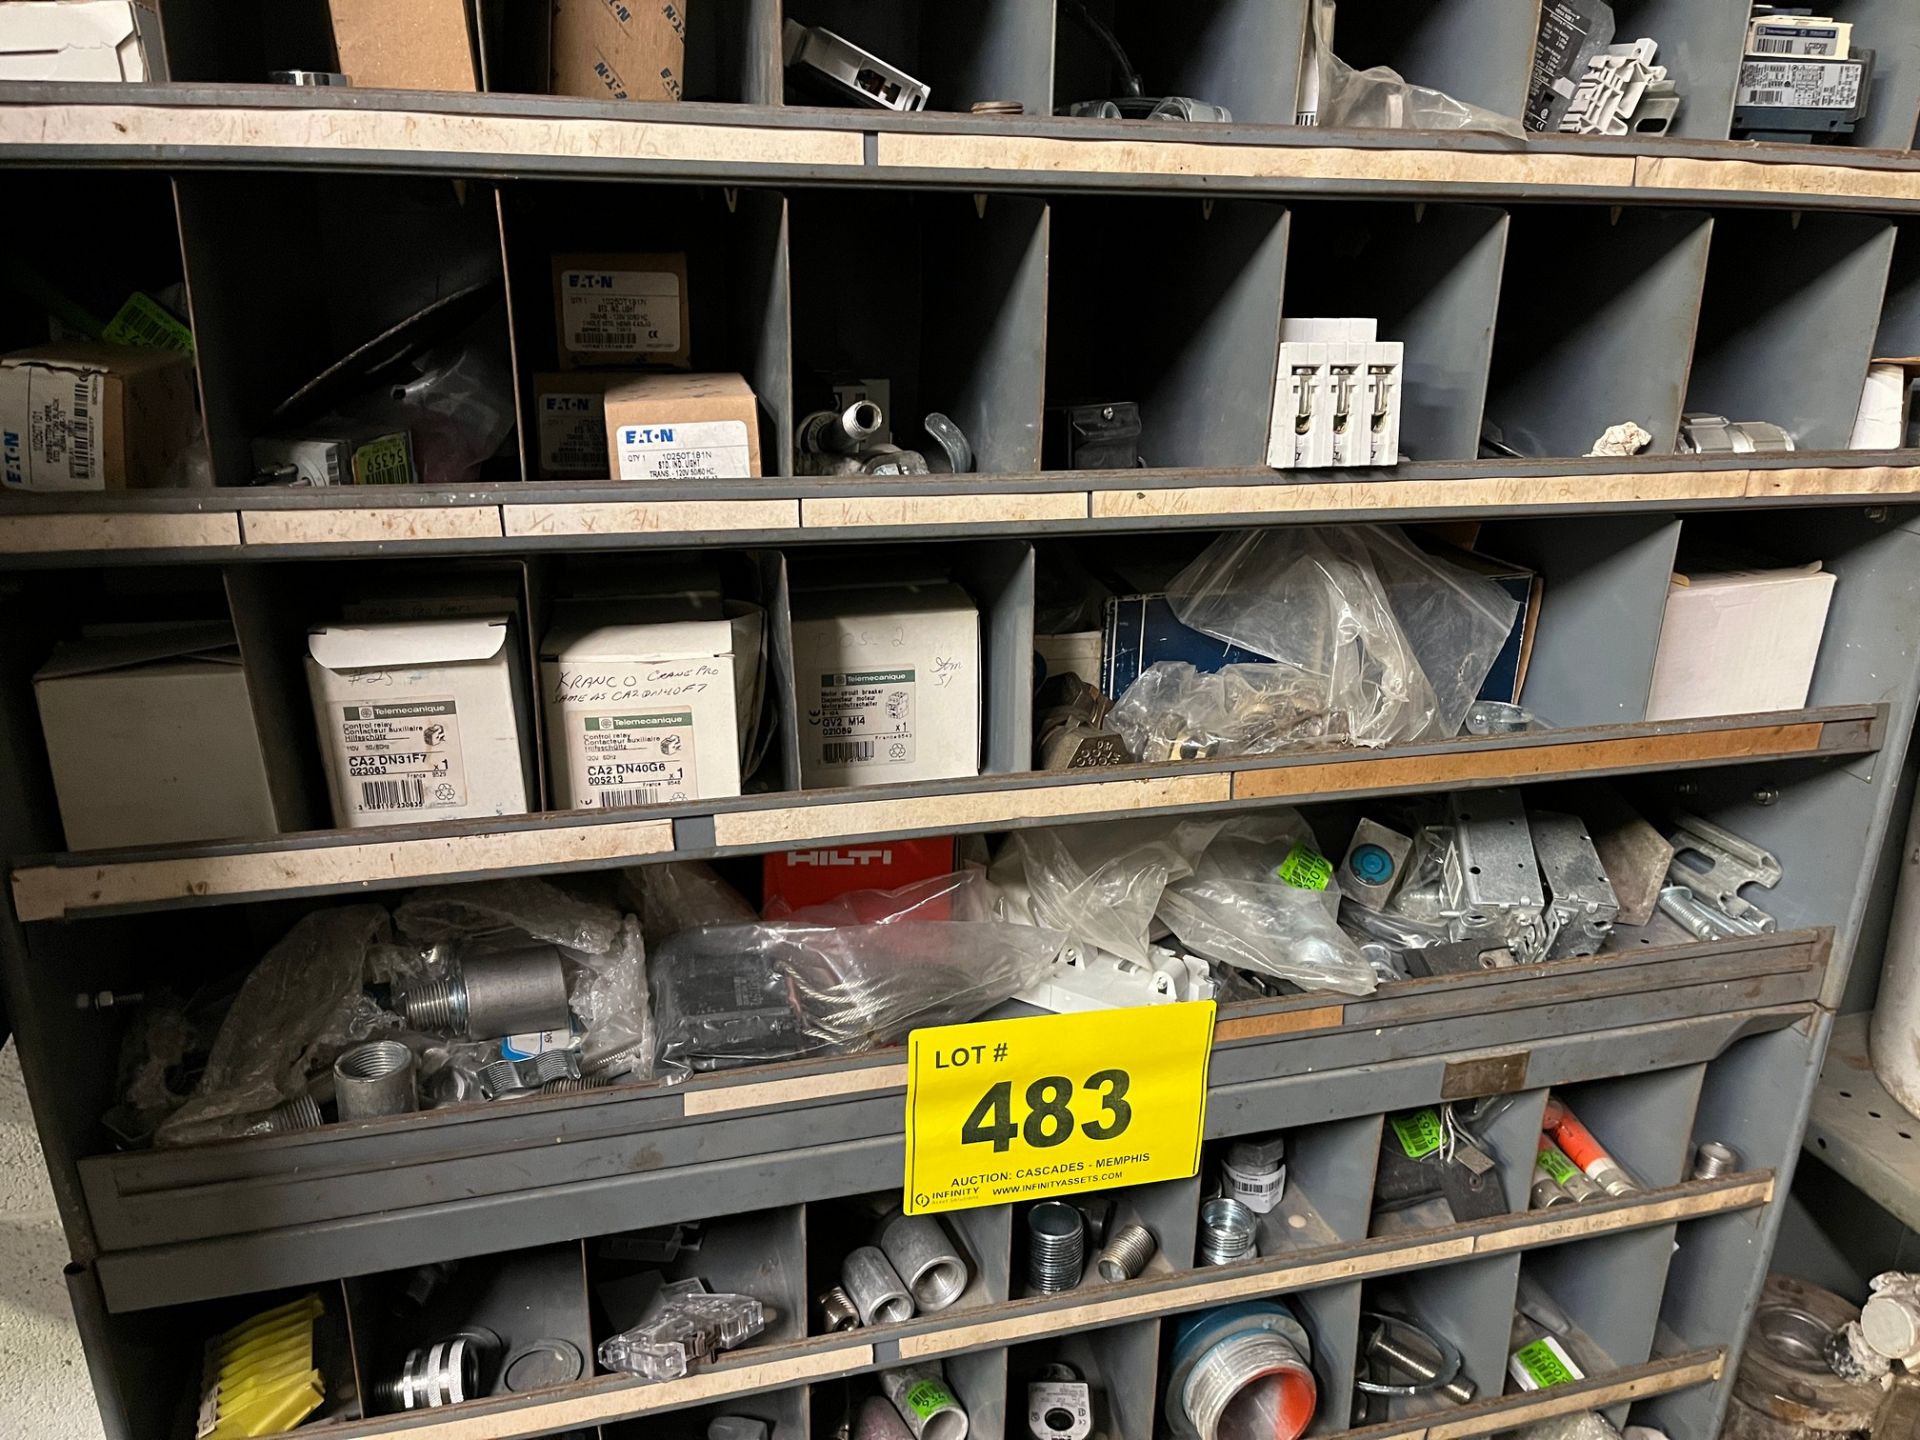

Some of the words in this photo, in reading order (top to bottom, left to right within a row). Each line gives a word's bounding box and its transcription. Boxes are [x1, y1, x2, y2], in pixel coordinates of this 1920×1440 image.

[568, 274, 613, 288] EATON
[625, 429, 673, 444] EATON
[4, 431, 21, 484] EATON
[366, 448, 404, 473] 54359
[848, 673, 906, 683] Telemecanique
[374, 705, 445, 715] Telemecanique
[343, 722, 372, 730] Control
[374, 722, 393, 730] relay
[614, 717, 682, 727] Telemecanique
[822, 718, 842, 728] GV2
[848, 716, 866, 727] M14
[349, 756, 375, 768] CA2
[379, 753, 427, 766] DN31F7
[442, 759, 449, 770] 1
[587, 766, 613, 776] CA2
[616, 762, 666, 774] DN40G6
[677, 767, 683, 779] 1
[588, 775, 624, 785] 005213
[787, 850, 892, 866] HILTI
[935, 1045, 986, 1069] LOT
[993, 1043, 1008, 1063] #
[961, 1068, 1133, 1153] 483
[950, 1171, 1012, 1188] AUCTION:
[1015, 1161, 1085, 1180] CASCADES
[1095, 1152, 1150, 1169] MEMPHIS
[932, 1187, 980, 1200] INFINITY
[992, 1171, 1123, 1196] WWW.INFINITYASSETS.COM
